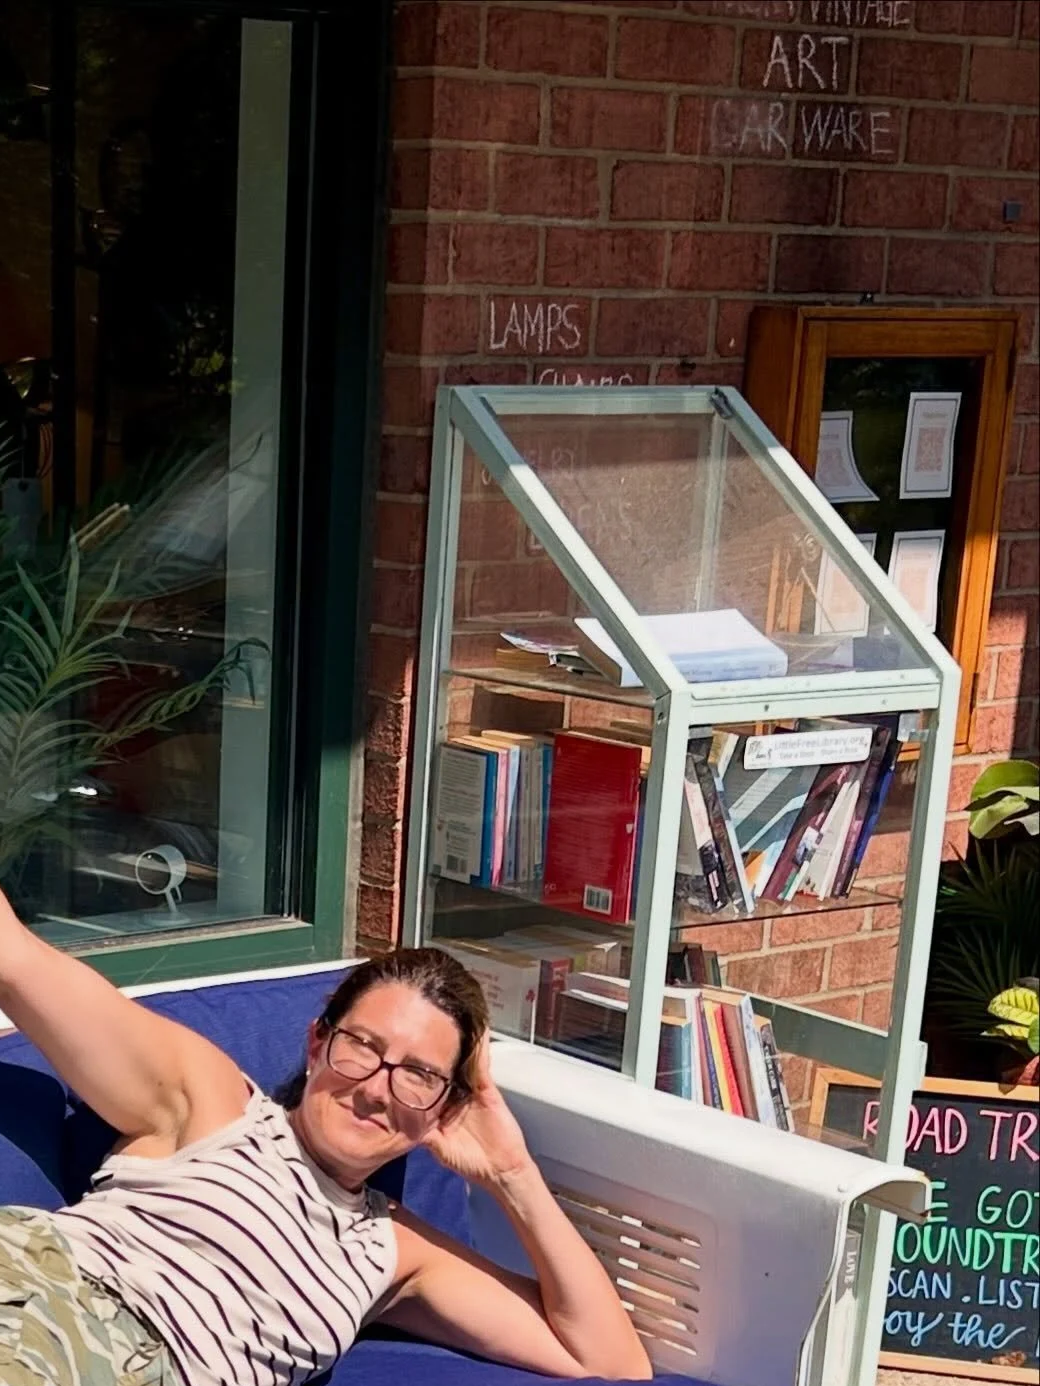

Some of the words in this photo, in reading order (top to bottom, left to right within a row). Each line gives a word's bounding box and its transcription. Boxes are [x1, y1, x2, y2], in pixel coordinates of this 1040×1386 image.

[762, 34, 850, 91] ART
[489, 301, 582, 352] LAMPS
[977, 1185, 1039, 1229] GO
[947, 1311, 1027, 1350] the
